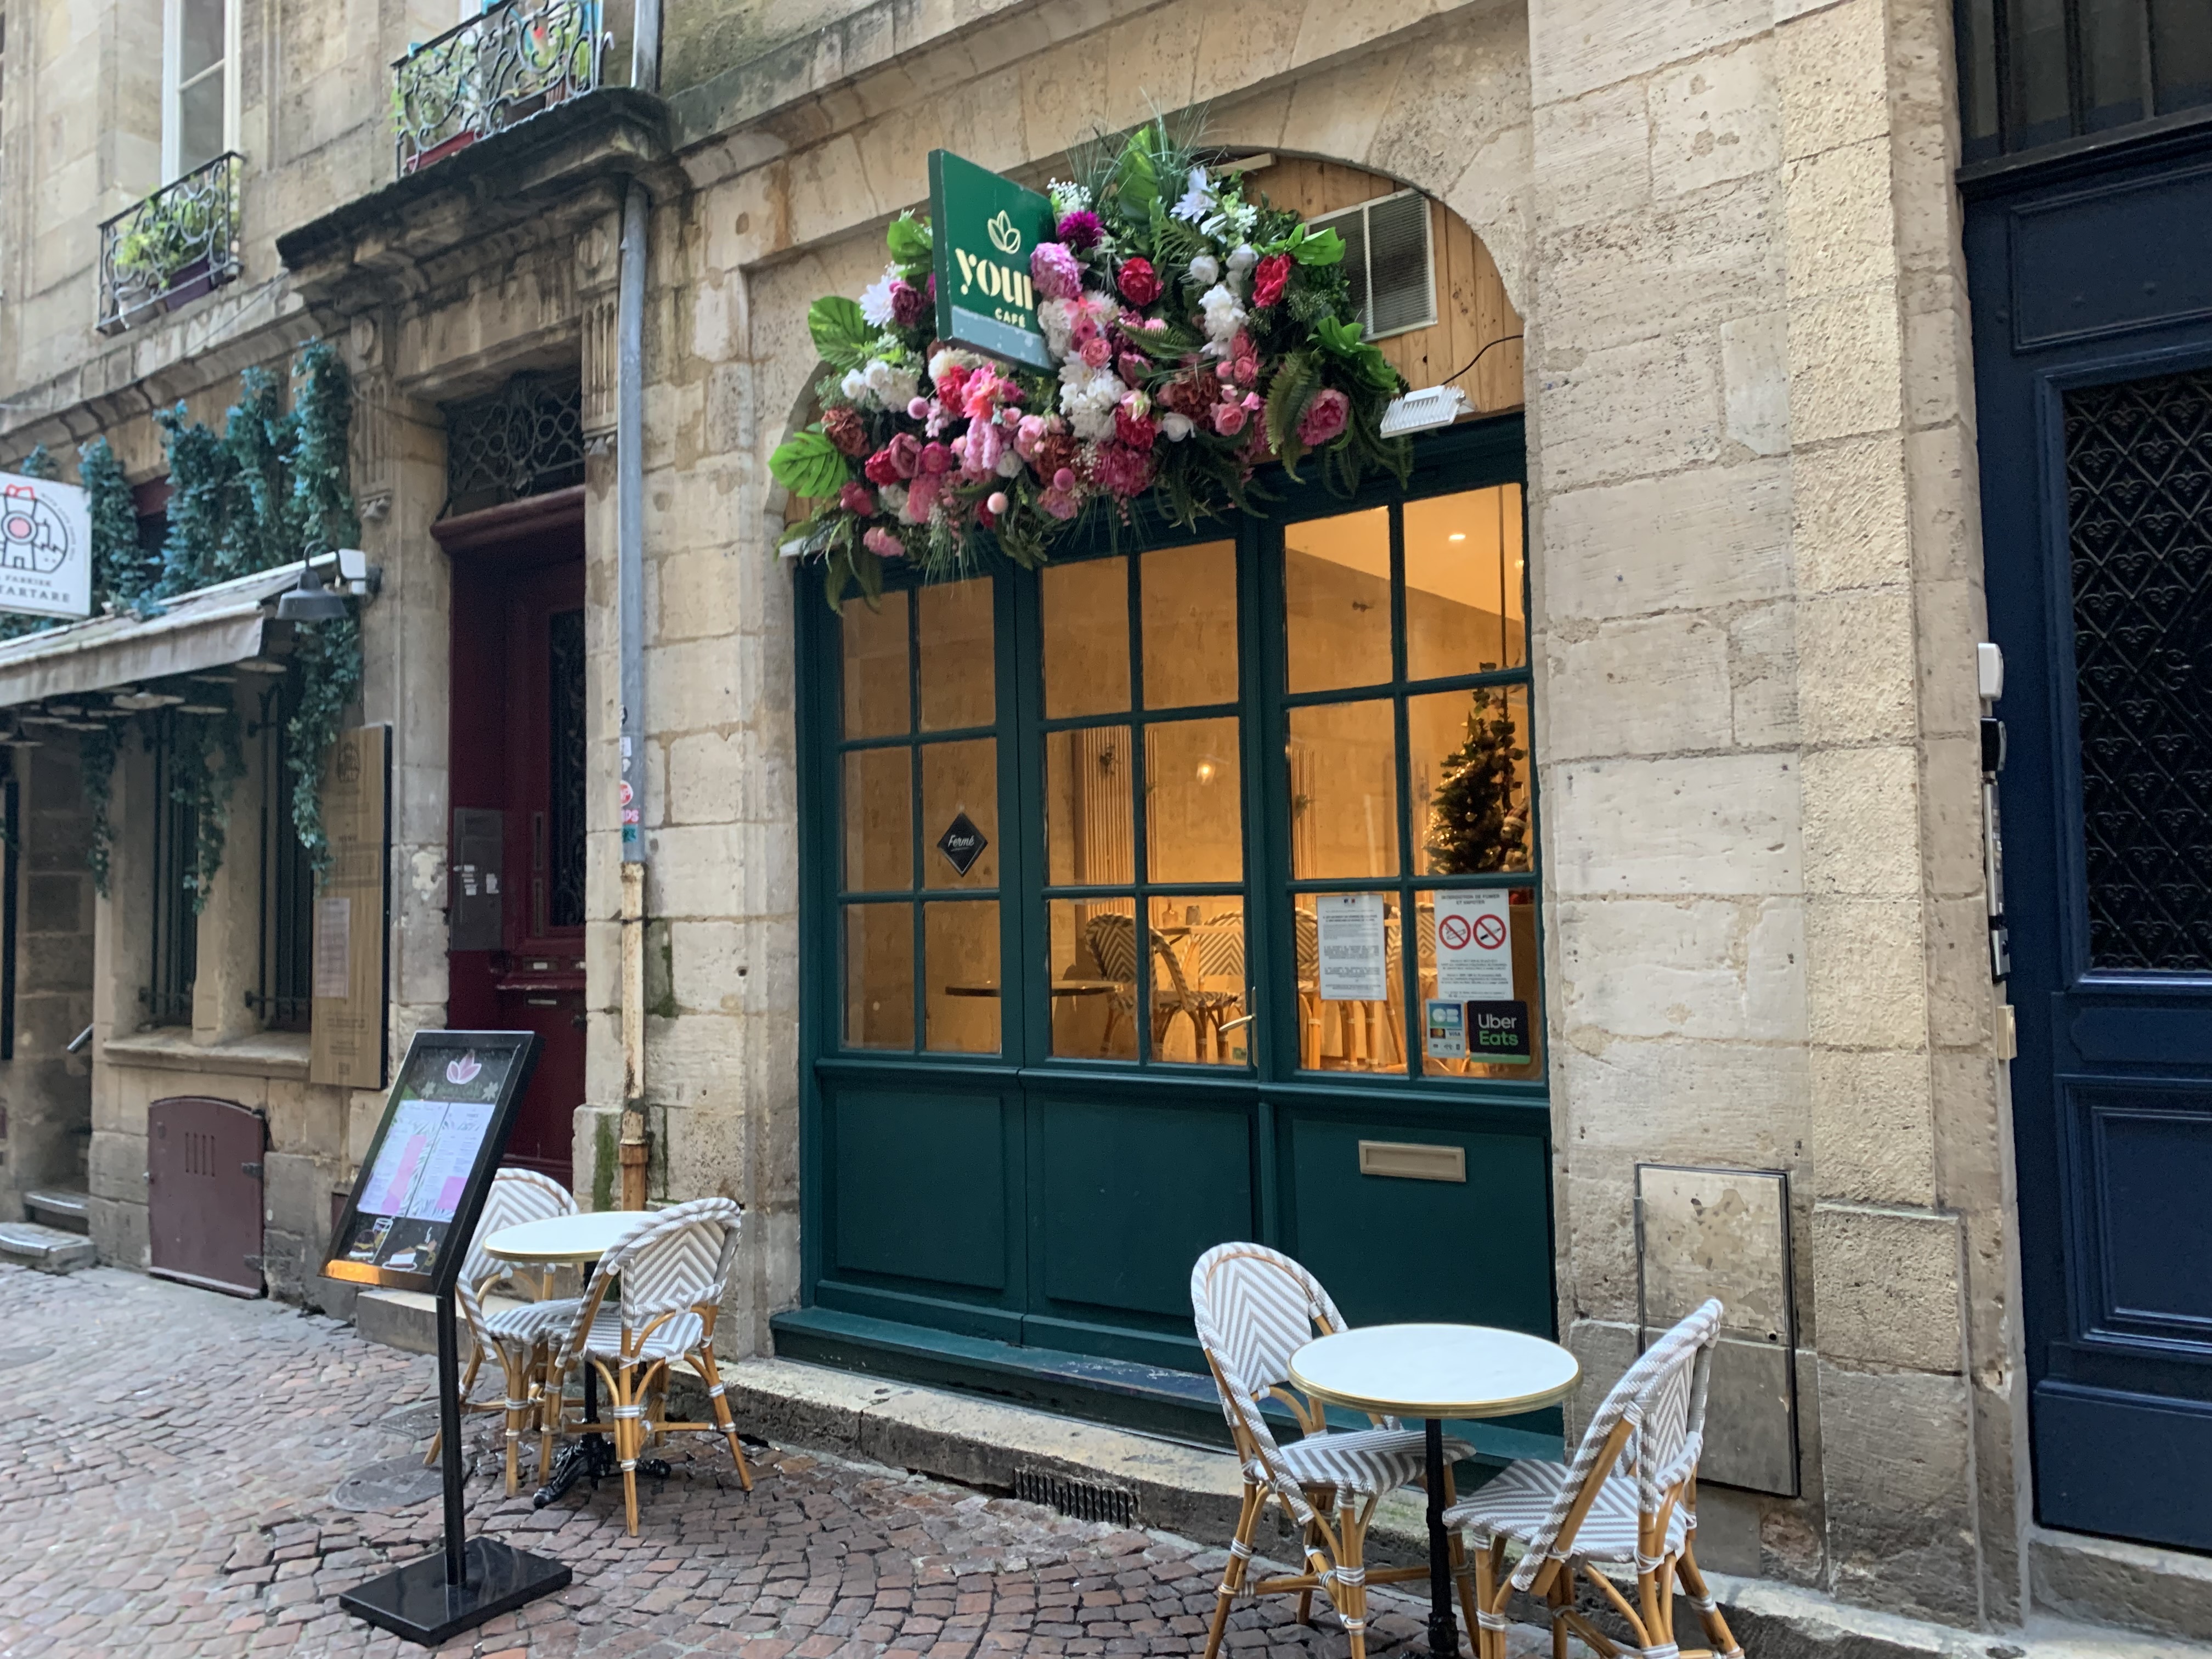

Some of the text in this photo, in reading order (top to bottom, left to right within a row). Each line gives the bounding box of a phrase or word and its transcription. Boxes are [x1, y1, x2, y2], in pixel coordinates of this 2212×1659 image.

[995, 307, 1025, 329] CAFÉ
[1478, 1013, 1517, 1029] Uber
[1479, 1030, 1519, 1046] Eats
